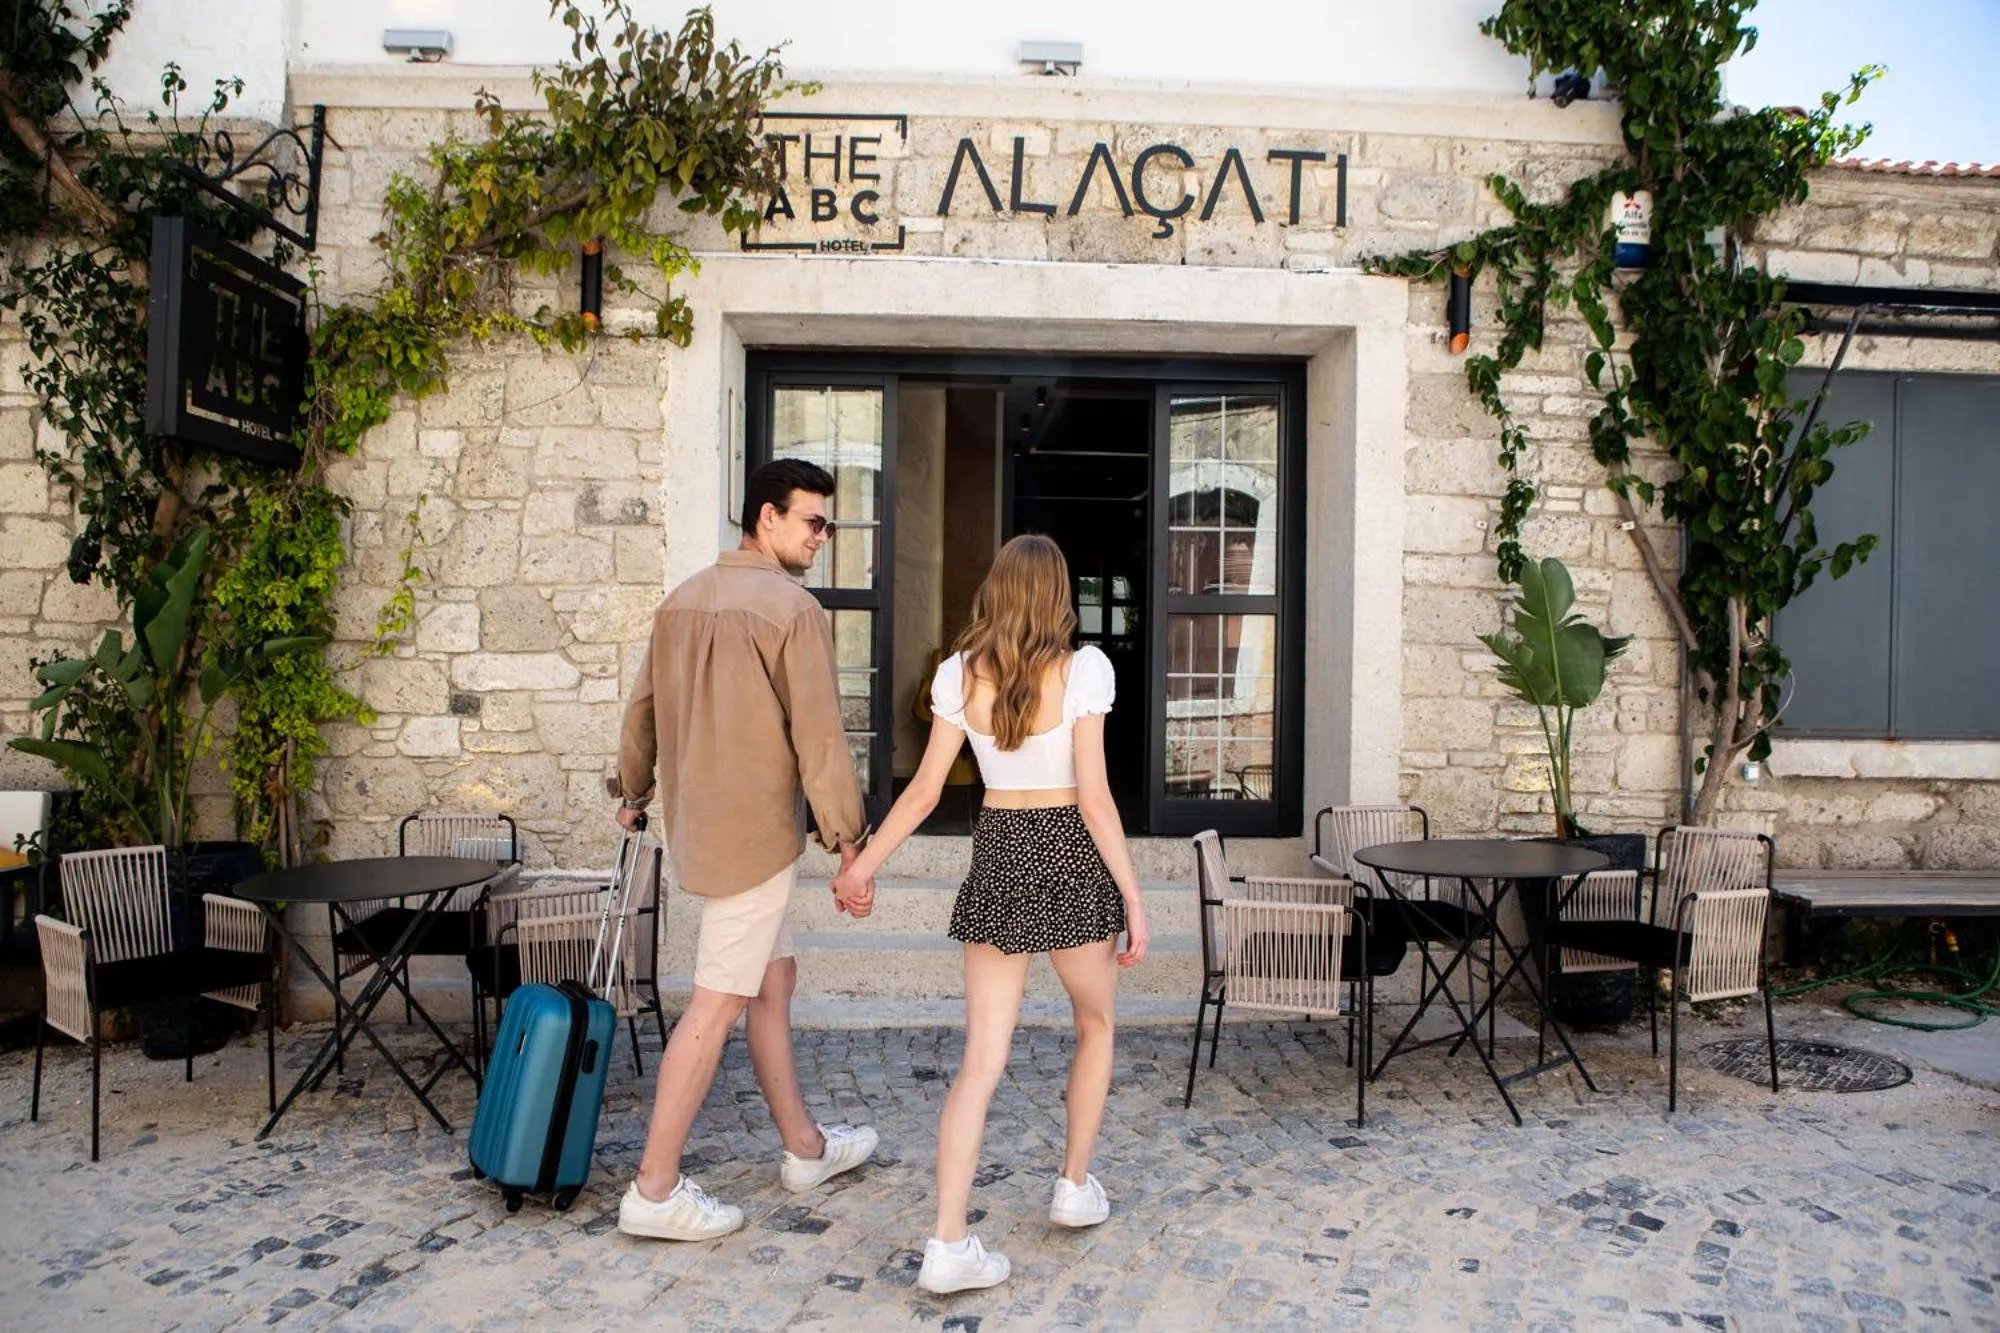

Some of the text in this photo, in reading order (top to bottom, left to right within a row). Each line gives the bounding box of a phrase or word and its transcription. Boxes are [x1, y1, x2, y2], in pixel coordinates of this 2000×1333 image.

[764, 133, 882, 183] THE
[763, 186, 881, 225] ABC
[936, 136, 1348, 239] ALAÇATI
[1624, 210, 1643, 220] Alfa
[820, 239, 869, 253] HOTEL
[204, 353, 281, 414] ABC
[241, 419, 274, 442] HOTEL
